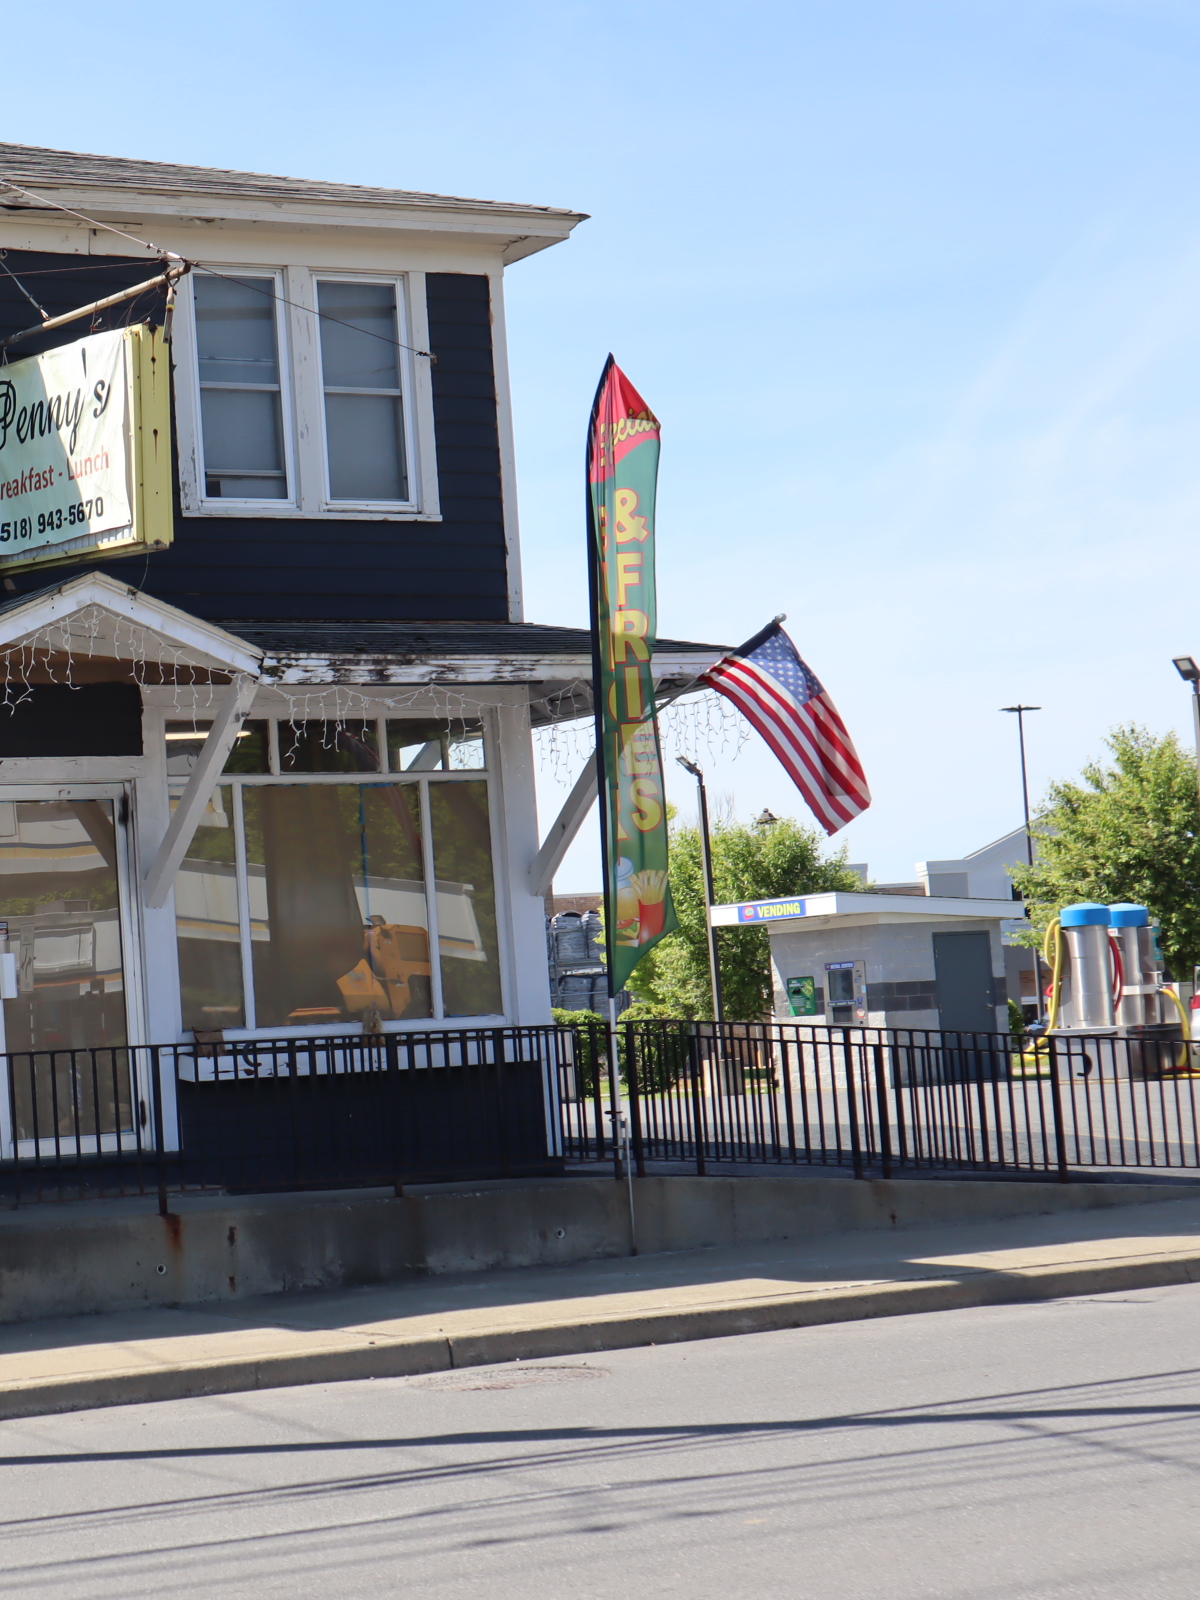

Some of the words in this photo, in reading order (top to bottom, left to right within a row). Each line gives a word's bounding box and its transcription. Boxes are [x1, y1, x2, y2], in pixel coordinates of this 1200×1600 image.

[67, 444, 110, 482] Lunch
[37, 496, 104, 535] 943-5670
[614, 551, 664, 833] FRIES
[757, 902, 801, 918] VENDING
